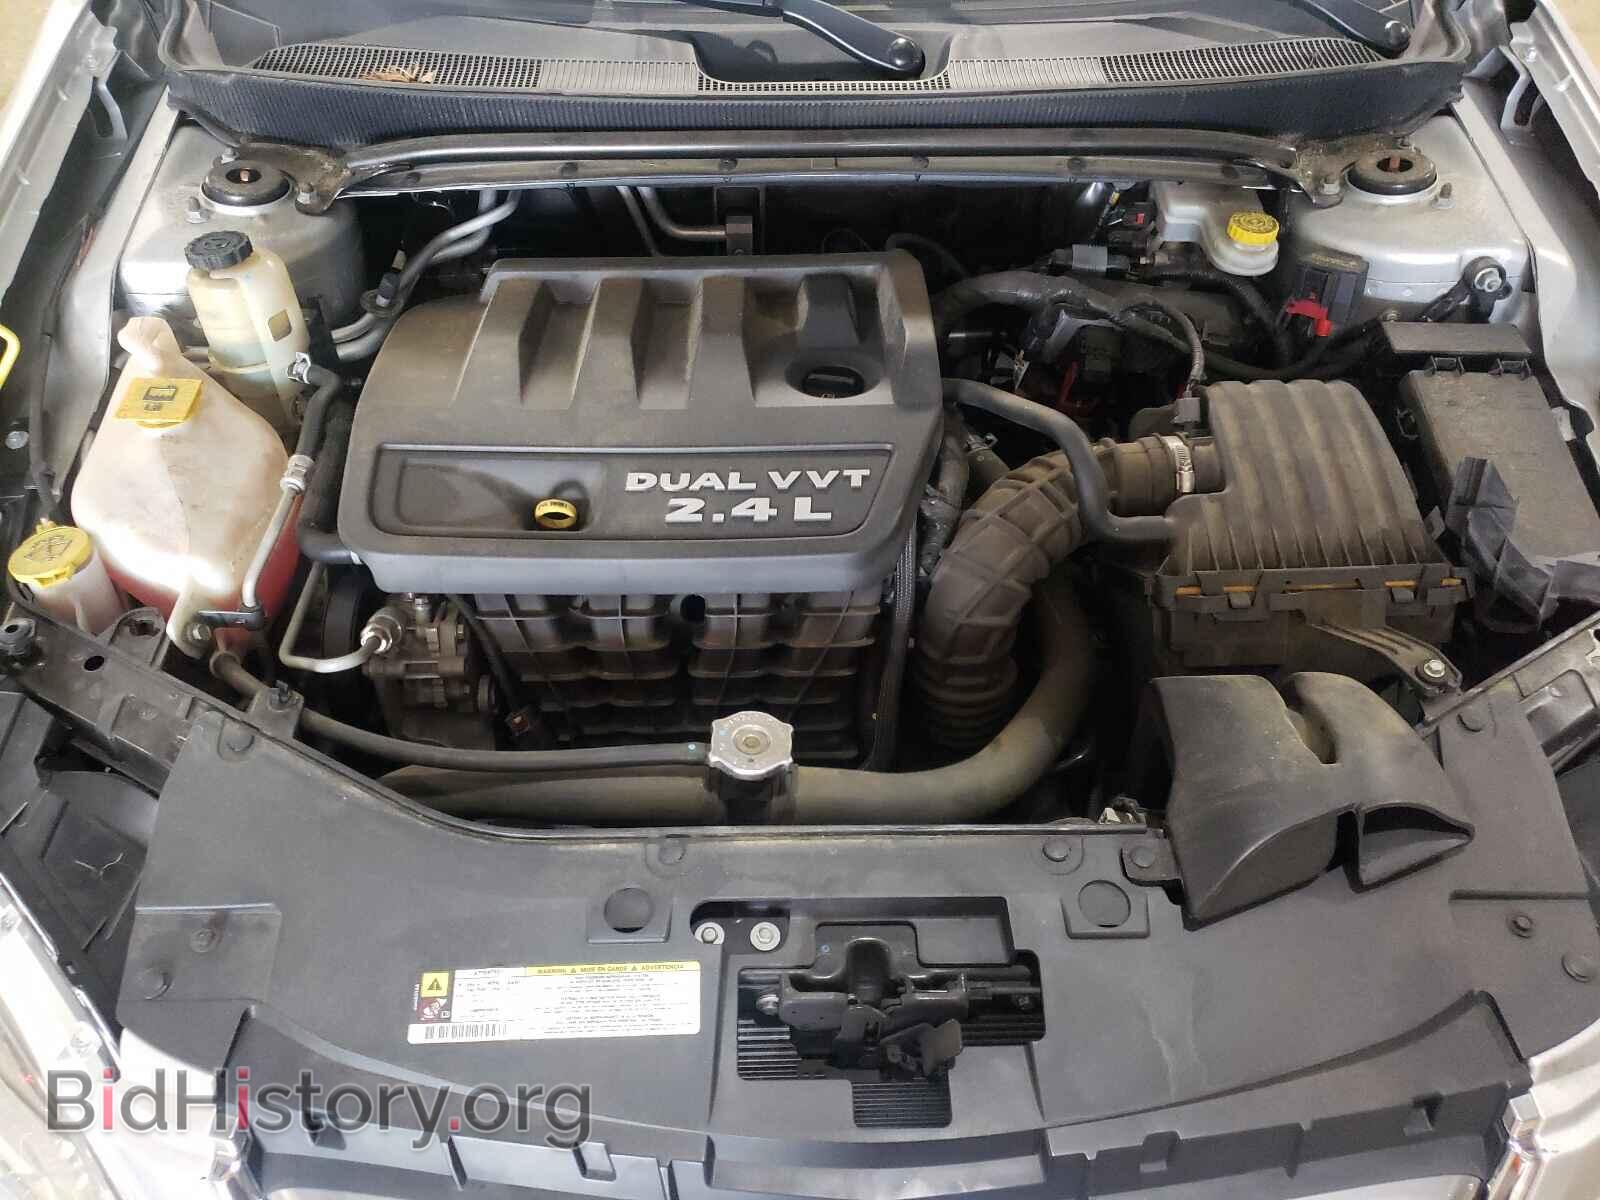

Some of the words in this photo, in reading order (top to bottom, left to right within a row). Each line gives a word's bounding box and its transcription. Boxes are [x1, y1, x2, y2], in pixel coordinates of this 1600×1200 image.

[625, 472, 757, 492] DUAL
[768, 469, 870, 489] VVT
[664, 498, 778, 523] 2.4
[793, 497, 832, 521] L
